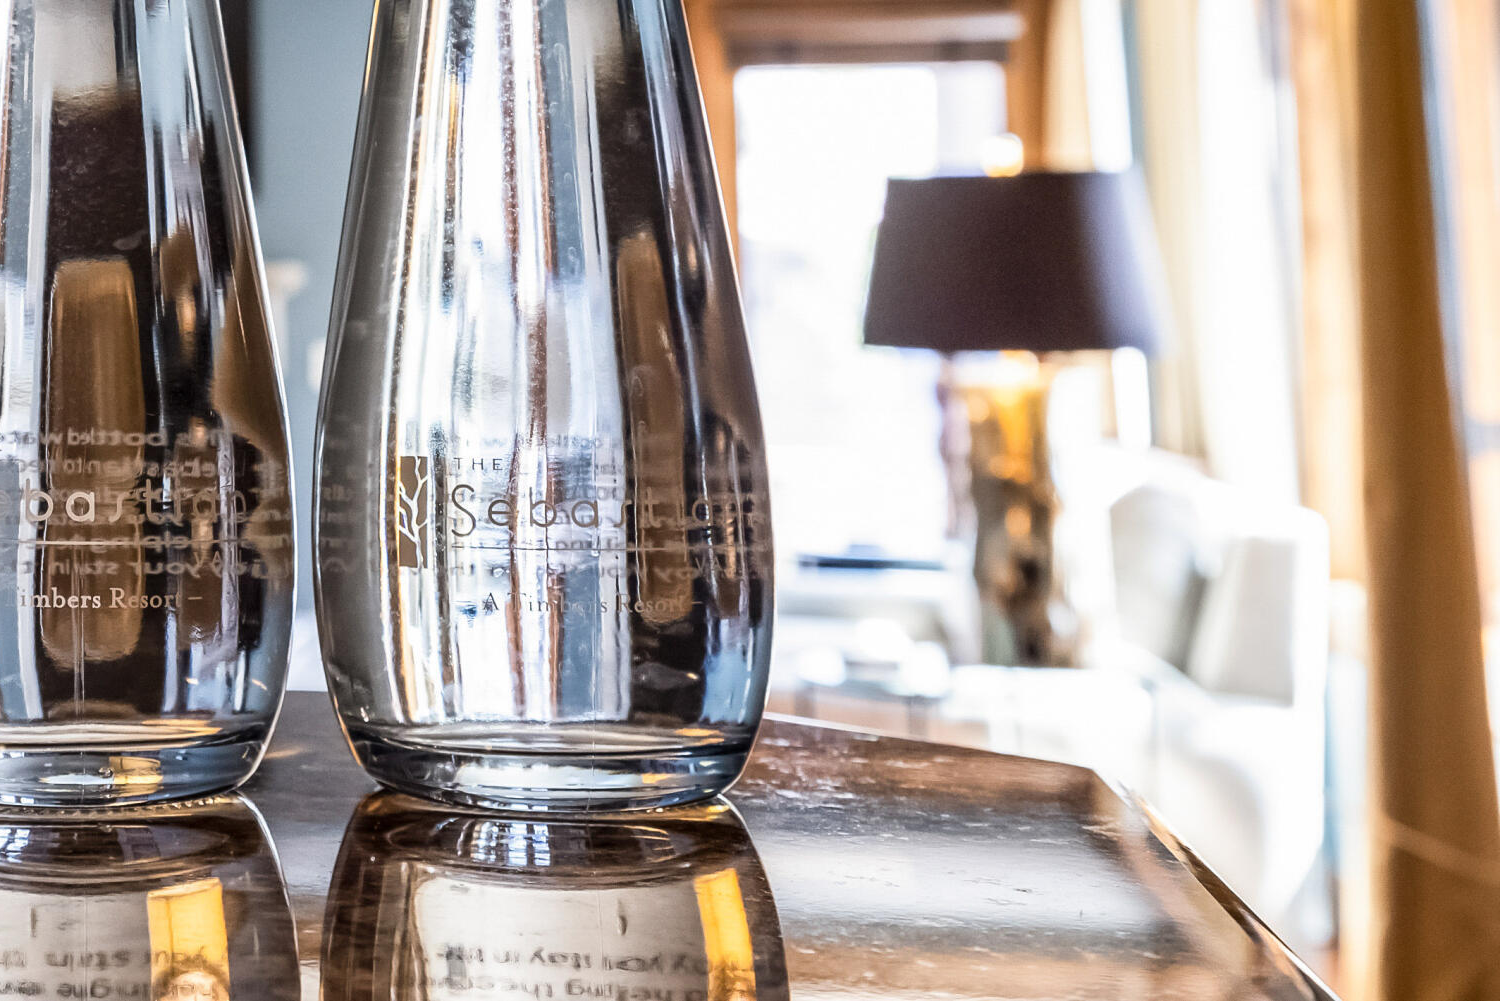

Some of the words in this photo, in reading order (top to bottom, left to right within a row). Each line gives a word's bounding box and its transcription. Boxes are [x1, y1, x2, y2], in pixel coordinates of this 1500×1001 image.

[456, 457, 504, 472] THE
[3, 586, 102, 609] imbers
[108, 586, 182, 609] Resort
